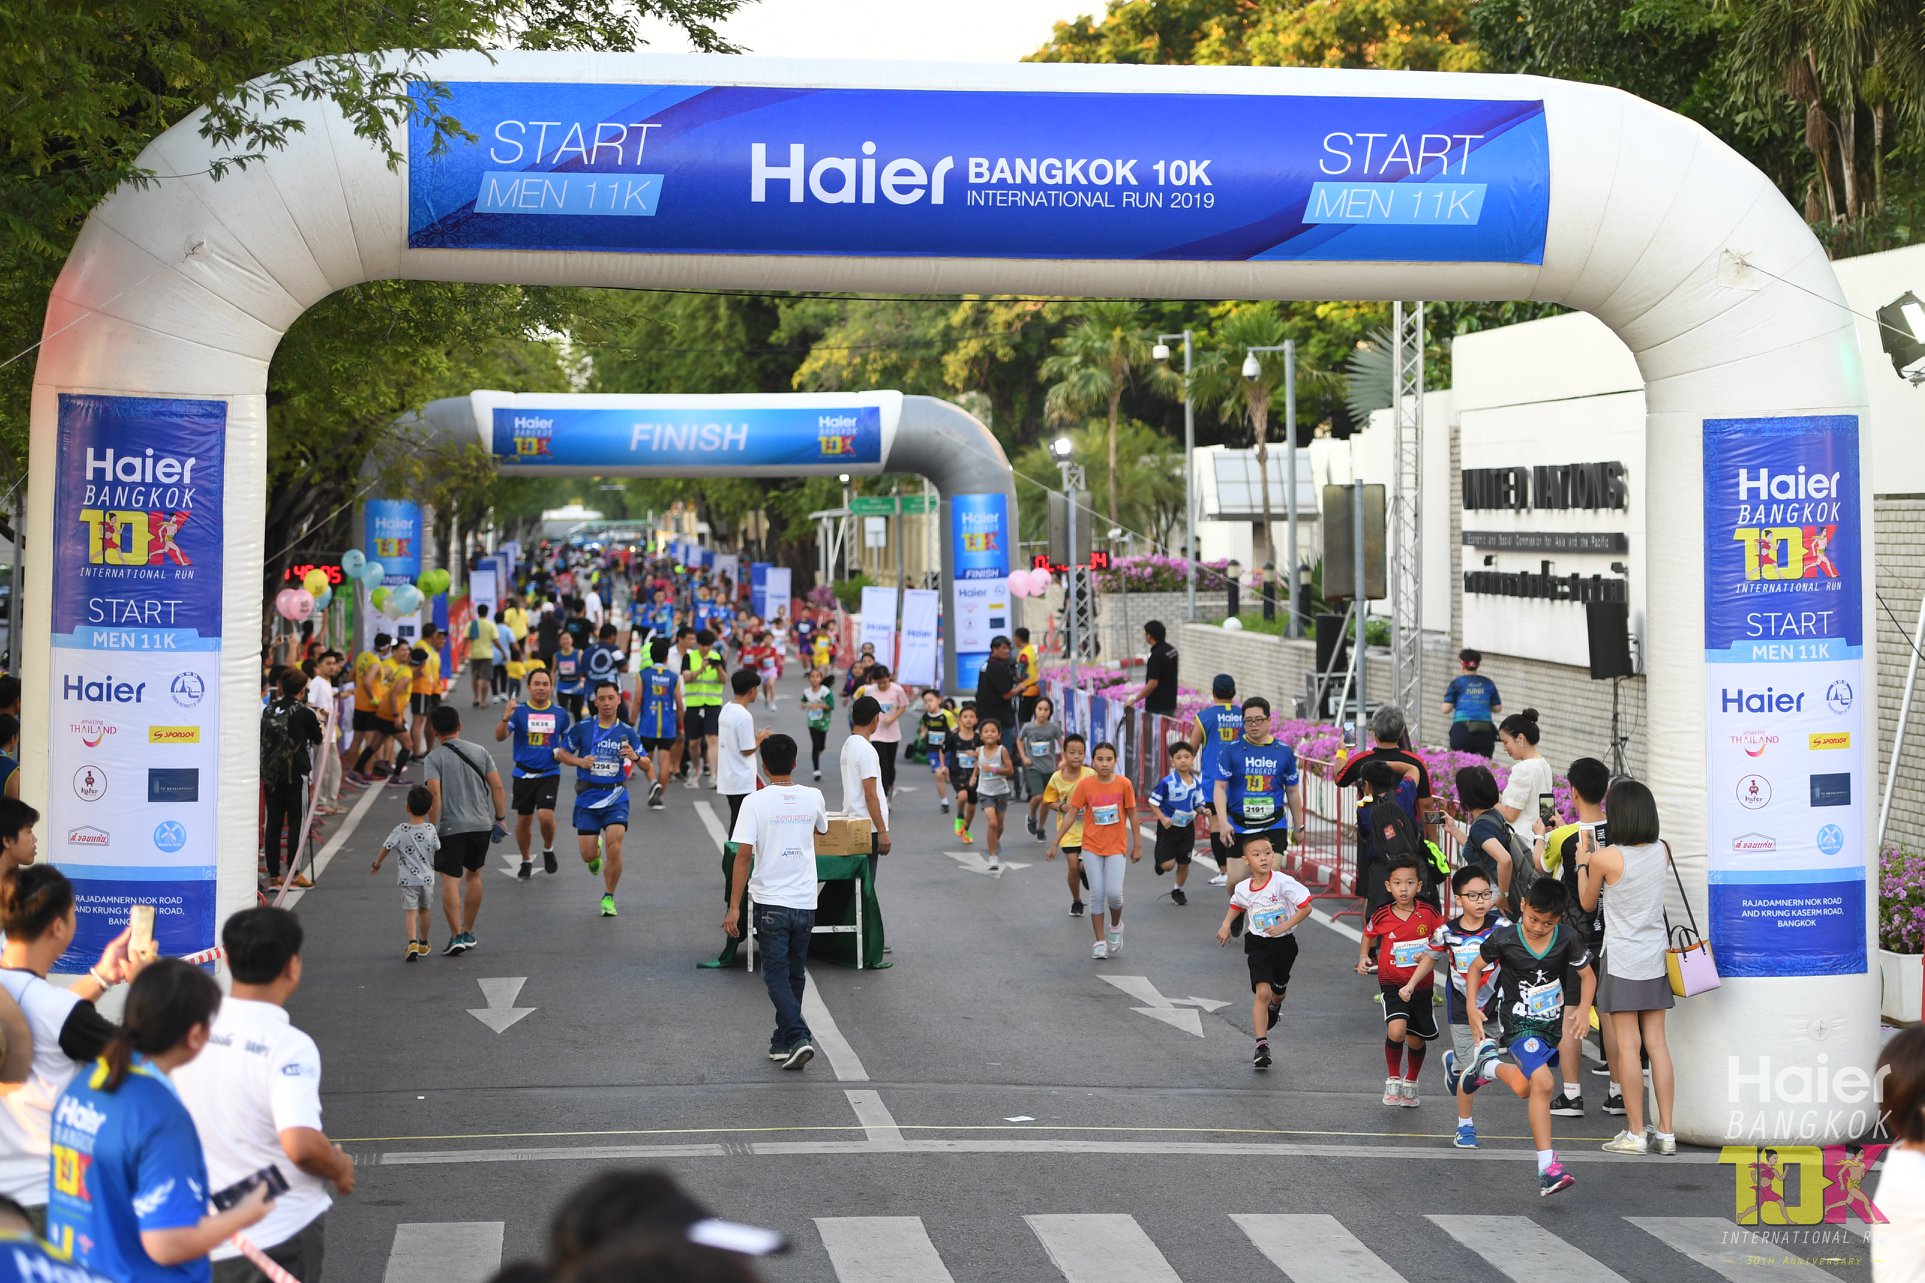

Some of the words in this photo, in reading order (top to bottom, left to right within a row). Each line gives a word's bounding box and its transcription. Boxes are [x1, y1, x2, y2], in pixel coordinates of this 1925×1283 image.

[490, 120, 662, 167] START
[1319, 132, 1484, 177] START
[751, 141, 954, 206] Haier
[967, 157, 1139, 186] BANGKOK
[1152, 160, 1213, 187] 10K
[487, 178, 567, 209] MEN
[586, 180, 652, 210] 11K
[967, 190, 1116, 209] INTERNATIONAL
[1122, 192, 1163, 209] RUN
[1170, 192, 1215, 210] 2019
[1315, 189, 1392, 219] MEN
[1411, 190, 1477, 220] 11K
[514, 416, 554, 429] Haier
[819, 415, 857, 428] Haier
[630, 423, 749, 452] FINISH
[86, 447, 197, 484] Haier
[1739, 465, 1841, 500] Haier
[83, 486, 197, 508] BANGKOK
[962, 512, 999, 524] Haier
[1737, 502, 1841, 525] BANGKOK
[375, 517, 413, 530] Haier
[79, 509, 192, 567] 10K
[1733, 525, 1841, 582] 10K
[80, 567, 167, 580] INTERNATIONAL
[174, 568, 195, 579] RUN
[1736, 582, 1820, 593] INTERNATIONAL
[1826, 581, 1842, 592] RUN
[89, 598, 183, 625] START
[1746, 611, 1834, 636] START
[92, 632, 135, 649] MEN
[141, 633, 177, 650] 11K
[1752, 644, 1794, 661] MEN
[1800, 642, 1830, 660] 11K
[63, 674, 147, 704] Haier
[1722, 687, 1805, 713] Haier
[70, 725, 117, 735] THAILAND
[1730, 736, 1780, 744] THAILAND
[1245, 756, 1278, 768] Haier
[1245, 768, 1278, 776] BANGKOK
[1244, 775, 1275, 792] 10K
[75, 895, 137, 905] RAJADAMNERN
[138, 896, 158, 904] NOK
[159, 896, 183, 904] ROAD
[1742, 899, 1804, 908] RAJADAMNERN
[1805, 898, 1822, 906] NOK
[1823, 897, 1842, 905] ROAD
[75, 906, 92, 914] AND
[92, 906, 122, 915] KRUNG
[159, 908, 185, 916] ROAD,
[1761, 909, 1791, 917] KRUNG
[1791, 908, 1822, 917] KASERM
[1777, 919, 1816, 927] BANGKOK
[56, 1093, 107, 1136] Haier
